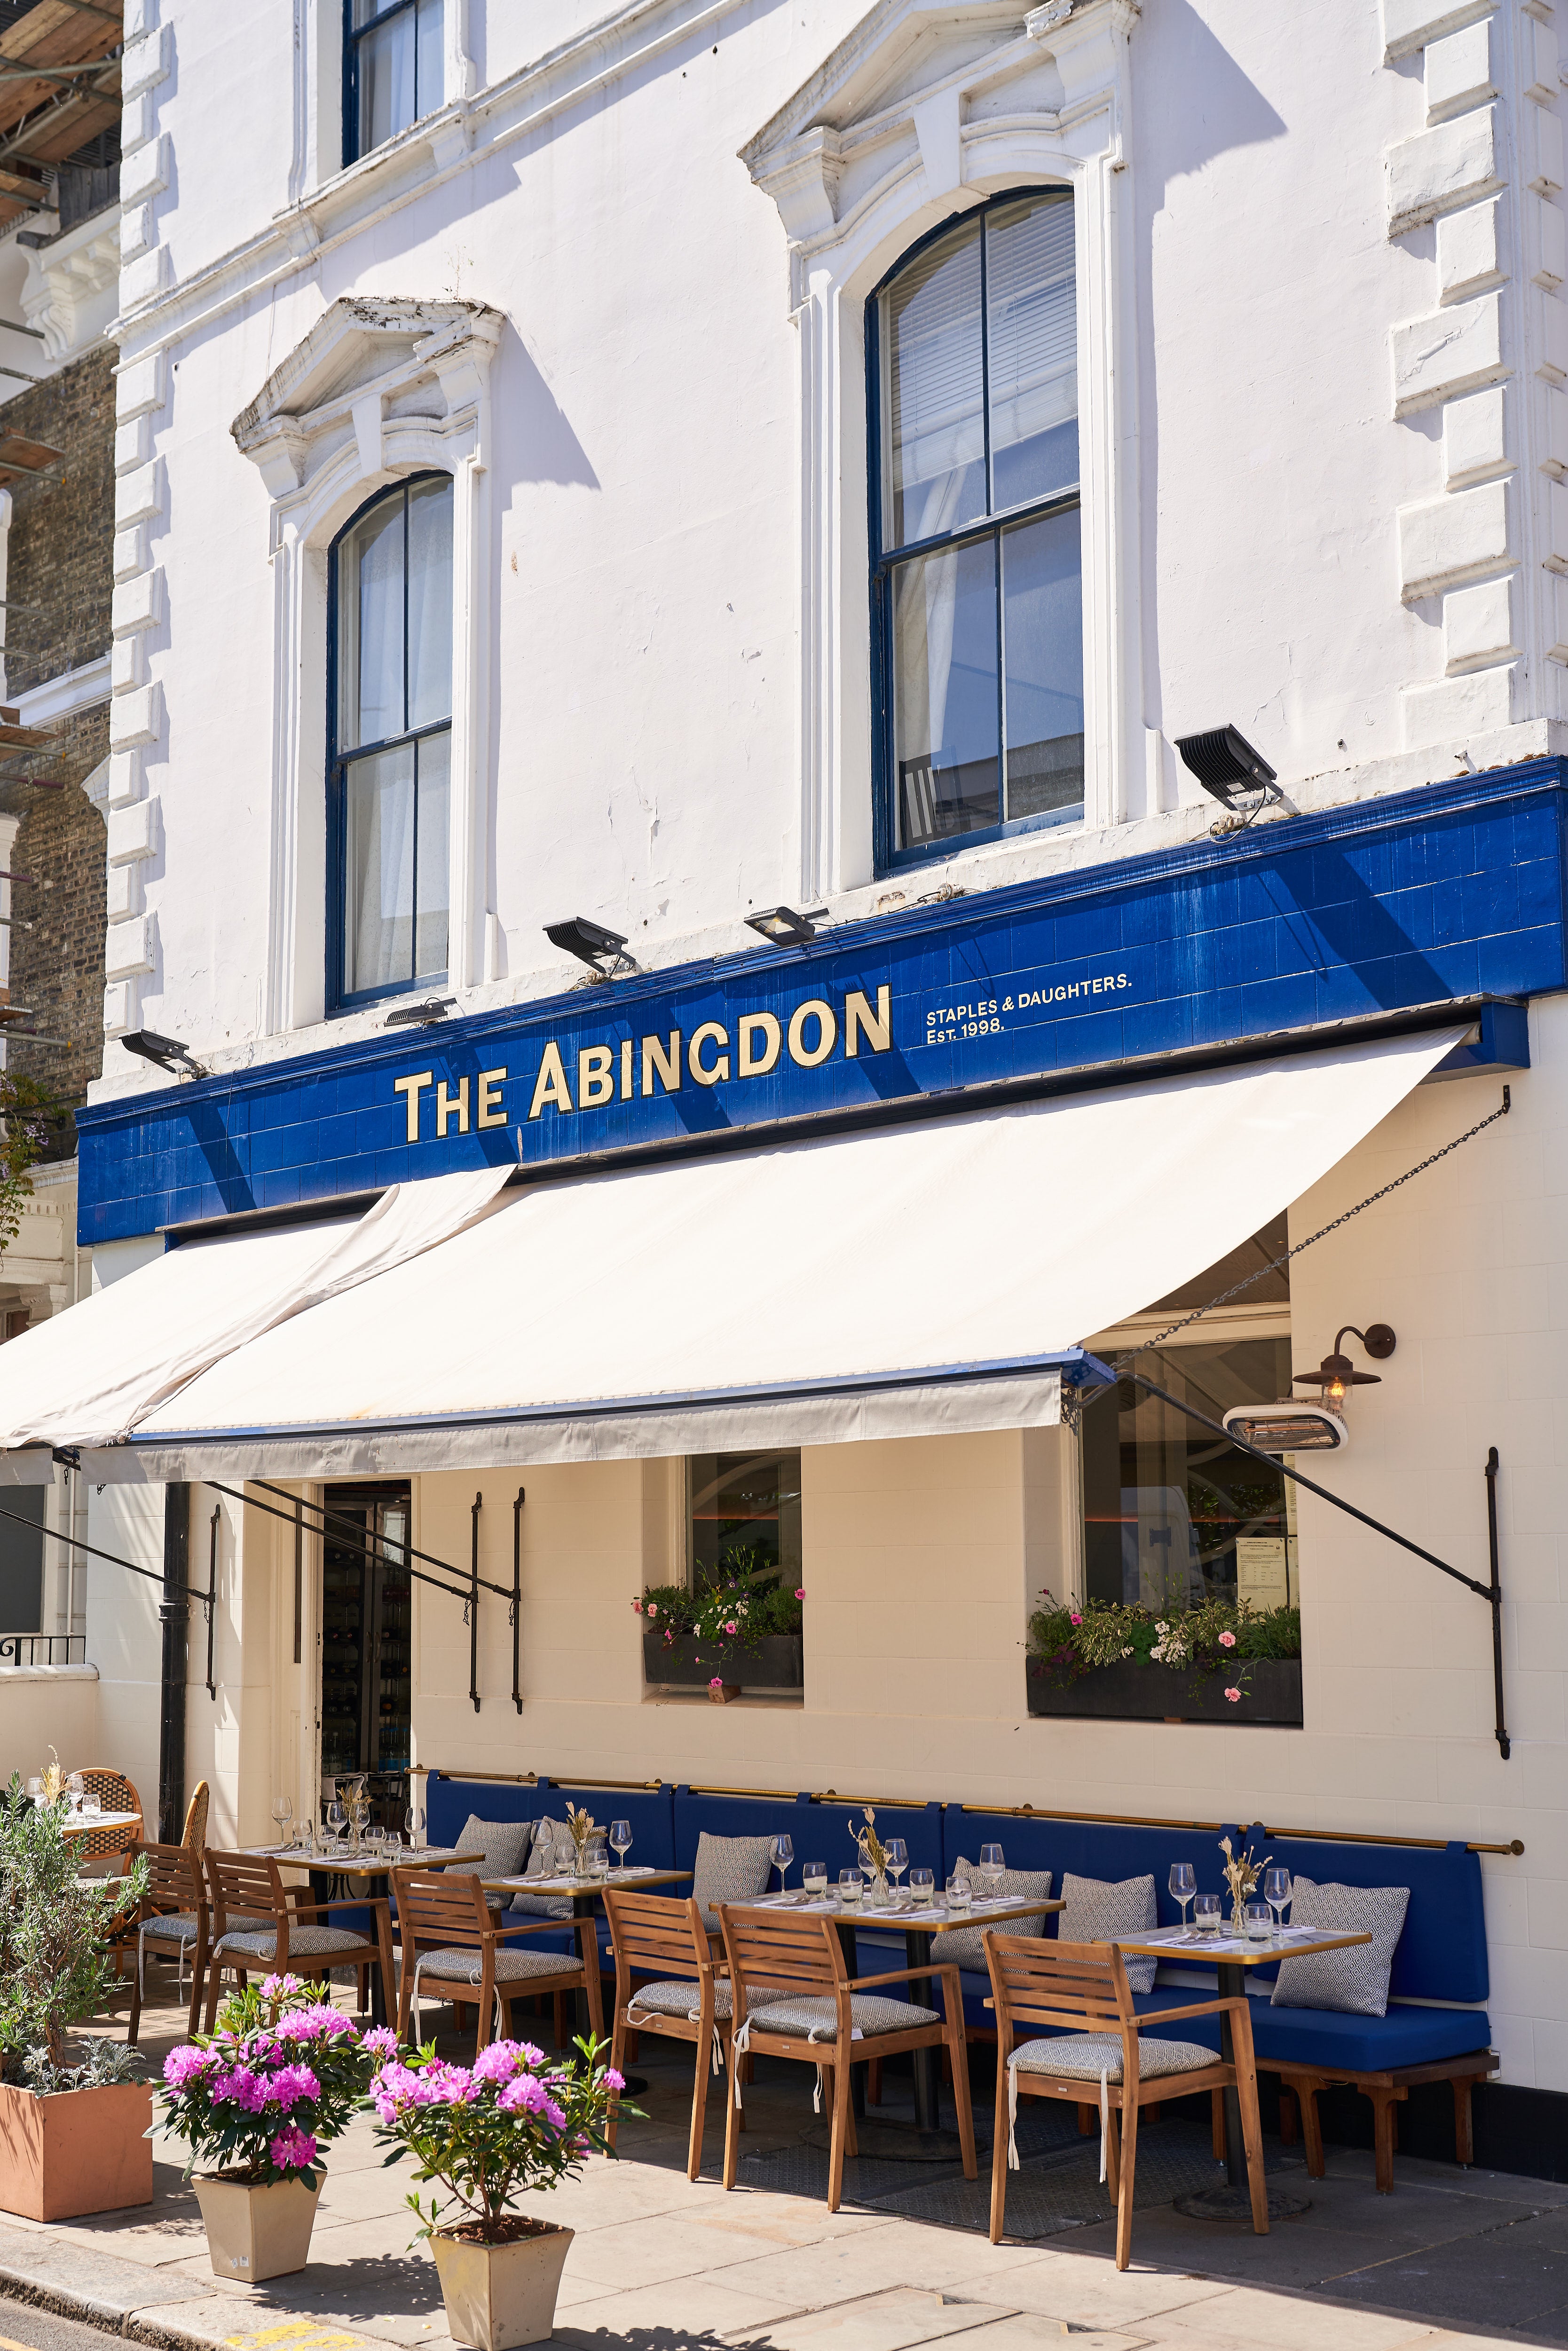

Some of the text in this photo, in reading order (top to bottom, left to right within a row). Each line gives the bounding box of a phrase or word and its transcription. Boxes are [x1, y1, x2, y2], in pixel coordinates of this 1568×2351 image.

[926, 973, 1133, 1026] STAPLES & DAUGHTERS.
[961, 1018, 1005, 1038] 1998.
[394, 984, 893, 1143] THE ABINGDON
